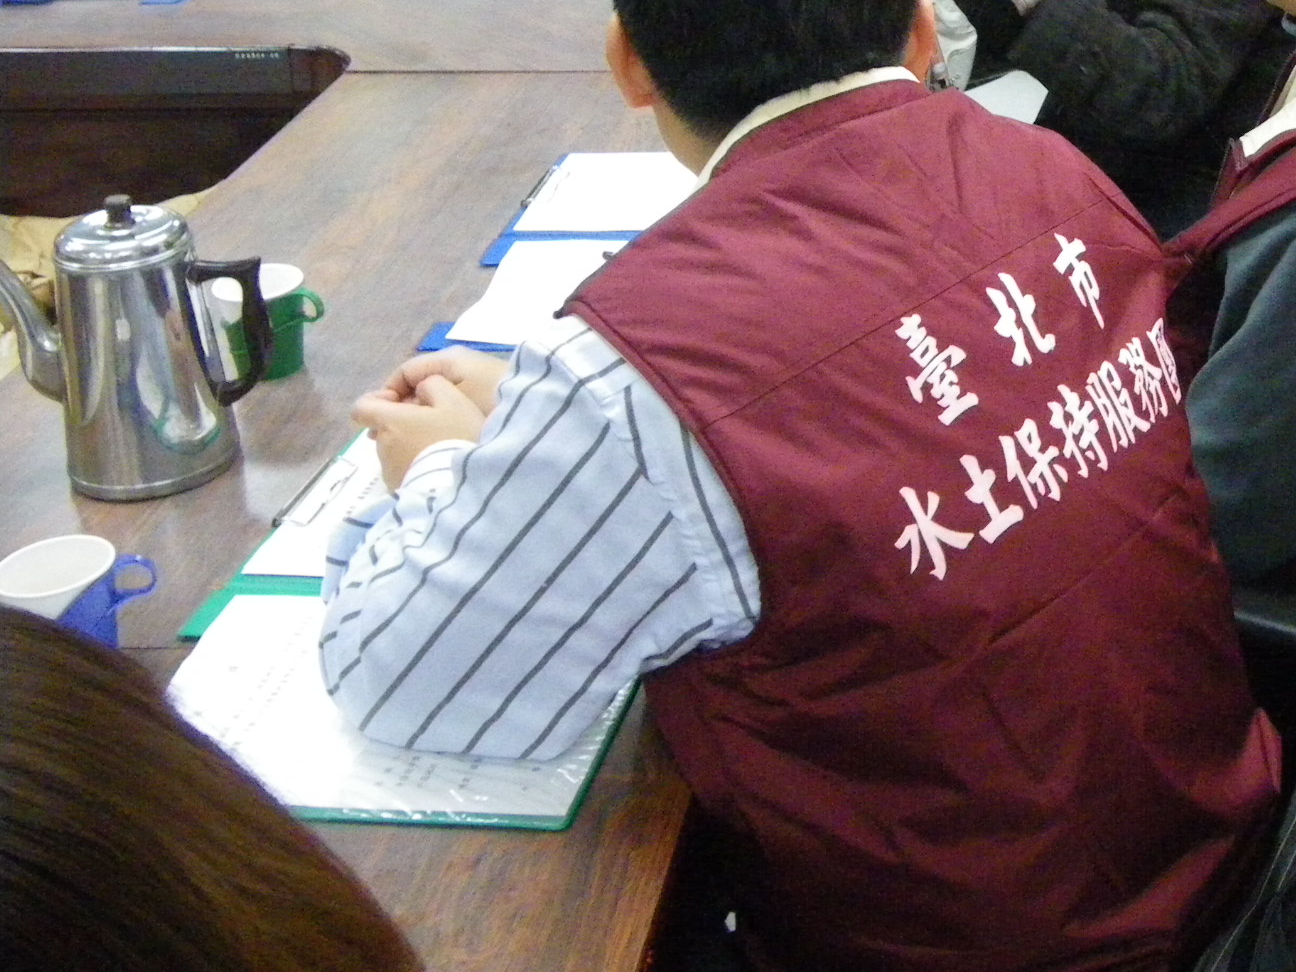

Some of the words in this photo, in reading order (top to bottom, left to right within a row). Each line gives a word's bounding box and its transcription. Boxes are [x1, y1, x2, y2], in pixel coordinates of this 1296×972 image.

[895, 233, 1105, 426] 臺北市
[894, 317, 1182, 580] 水土保持服務團
